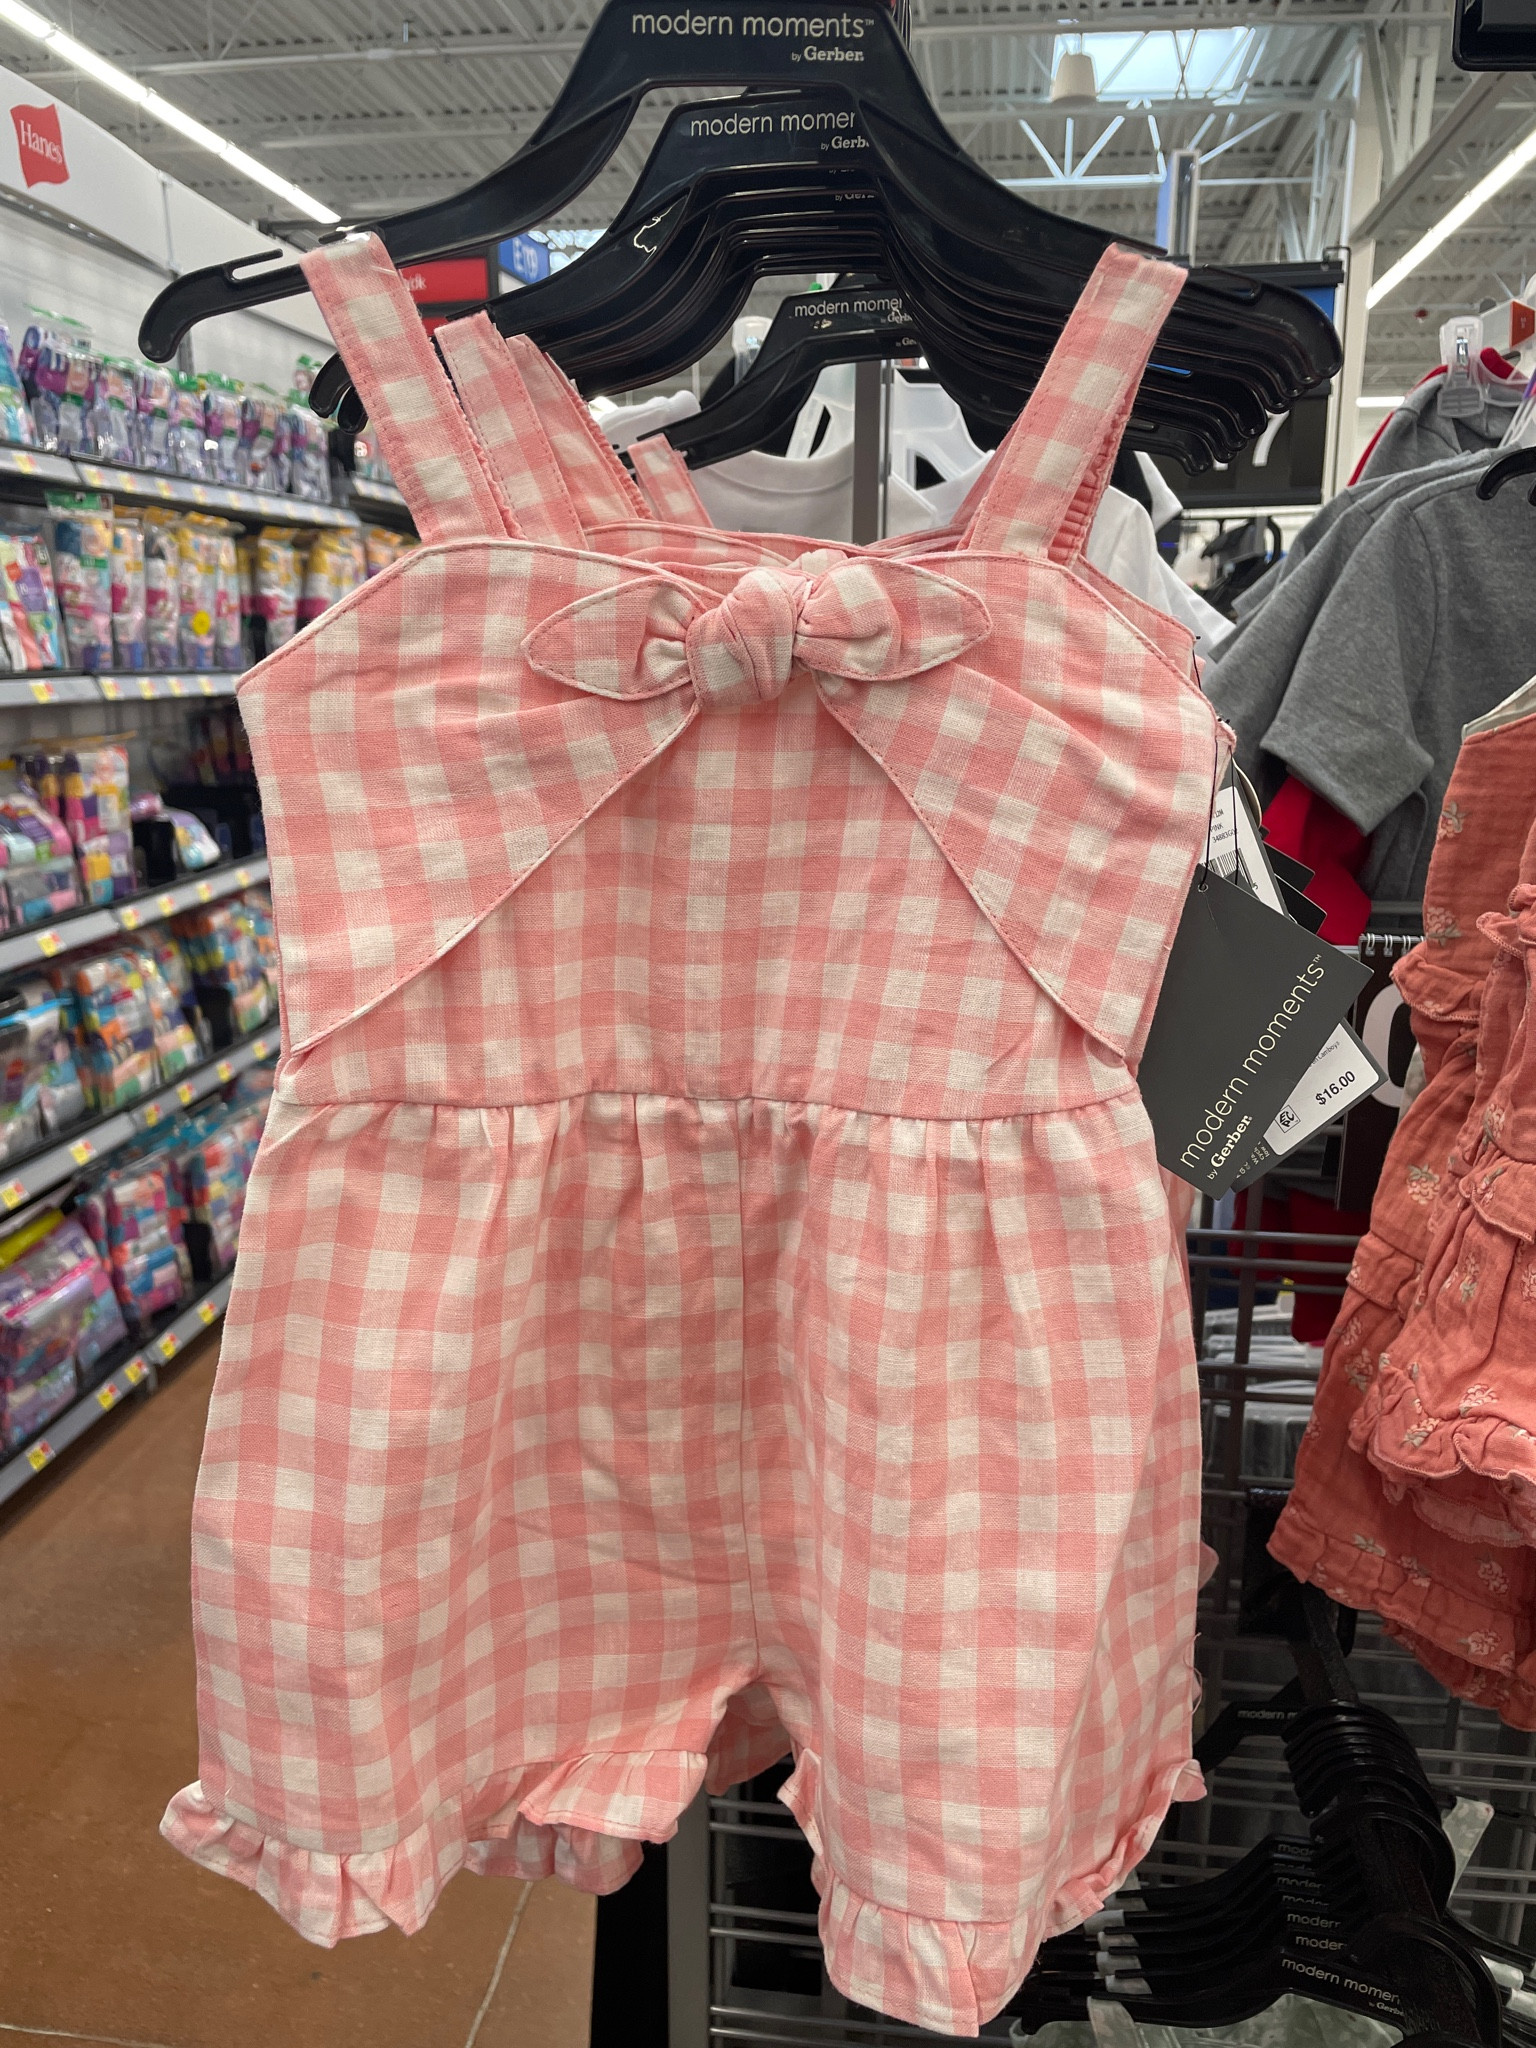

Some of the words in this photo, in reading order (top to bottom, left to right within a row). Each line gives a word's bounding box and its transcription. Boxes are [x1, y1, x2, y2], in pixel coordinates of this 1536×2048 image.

[632, 9, 733, 36] modern
[791, 52, 801, 63] by
[690, 113, 773, 136] modern
[20, 119, 63, 165] Hanes
[794, 300, 849, 317] modern
[1315, 1071, 1355, 1105] $16.00
[1180, 1076, 1249, 1169] modern
[1207, 1168, 1219, 1180] by
[1281, 1957, 1341, 1985] modern
